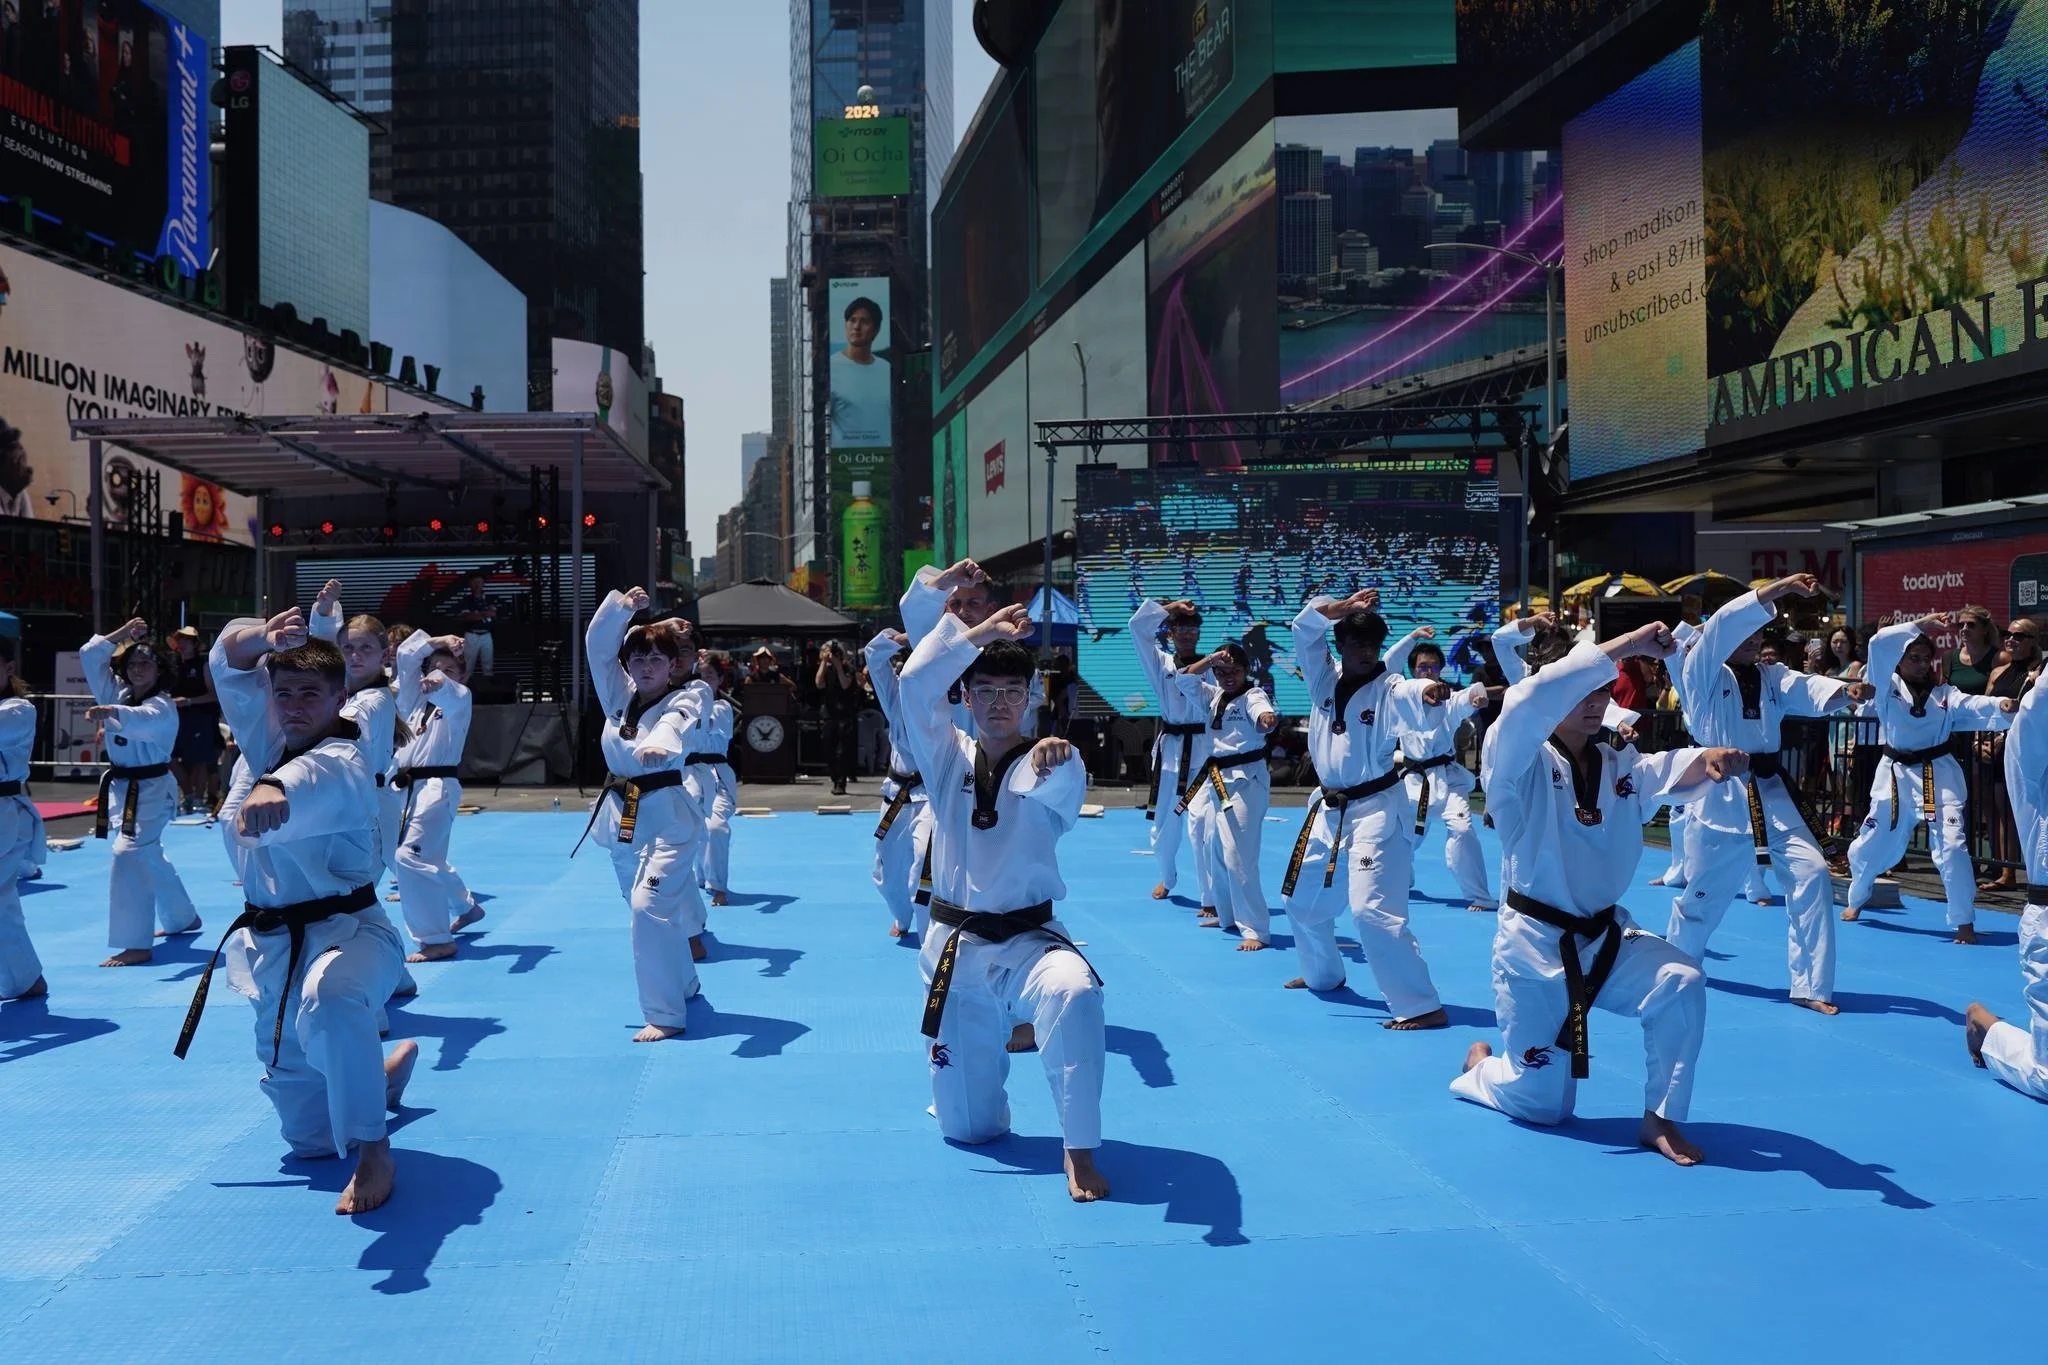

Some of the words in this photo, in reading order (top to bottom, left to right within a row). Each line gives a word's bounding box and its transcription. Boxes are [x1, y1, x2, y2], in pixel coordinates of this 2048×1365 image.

[1174, 49, 1196, 94] THE
[1198, 6, 1230, 68] BEAR
[231, 96, 249, 109] LG
[844, 104, 880, 119] 2024
[10, 114, 88, 160] EVOLUTION
[822, 147, 845, 164] Oi
[854, 146, 904, 162] Ocha
[3, 136, 41, 162] SEASON
[42, 153, 64, 173] NOW
[64, 165, 113, 195] STREAMING
[1583, 238, 1618, 268] shop
[1624, 200, 1696, 248] madison
[1610, 271, 1621, 293] &
[1626, 252, 1661, 285] east
[1668, 233, 1705, 268] 87th
[1711, 290, 1997, 426] AMERICAN
[3, 346, 97, 396] MILLION
[104, 373, 211, 418] IMAGINARY
[839, 454, 852, 464] Oi
[856, 452, 885, 464] Ocha
[1903, 571, 1965, 592] todaytix
[1936, 632, 1951, 648] at
